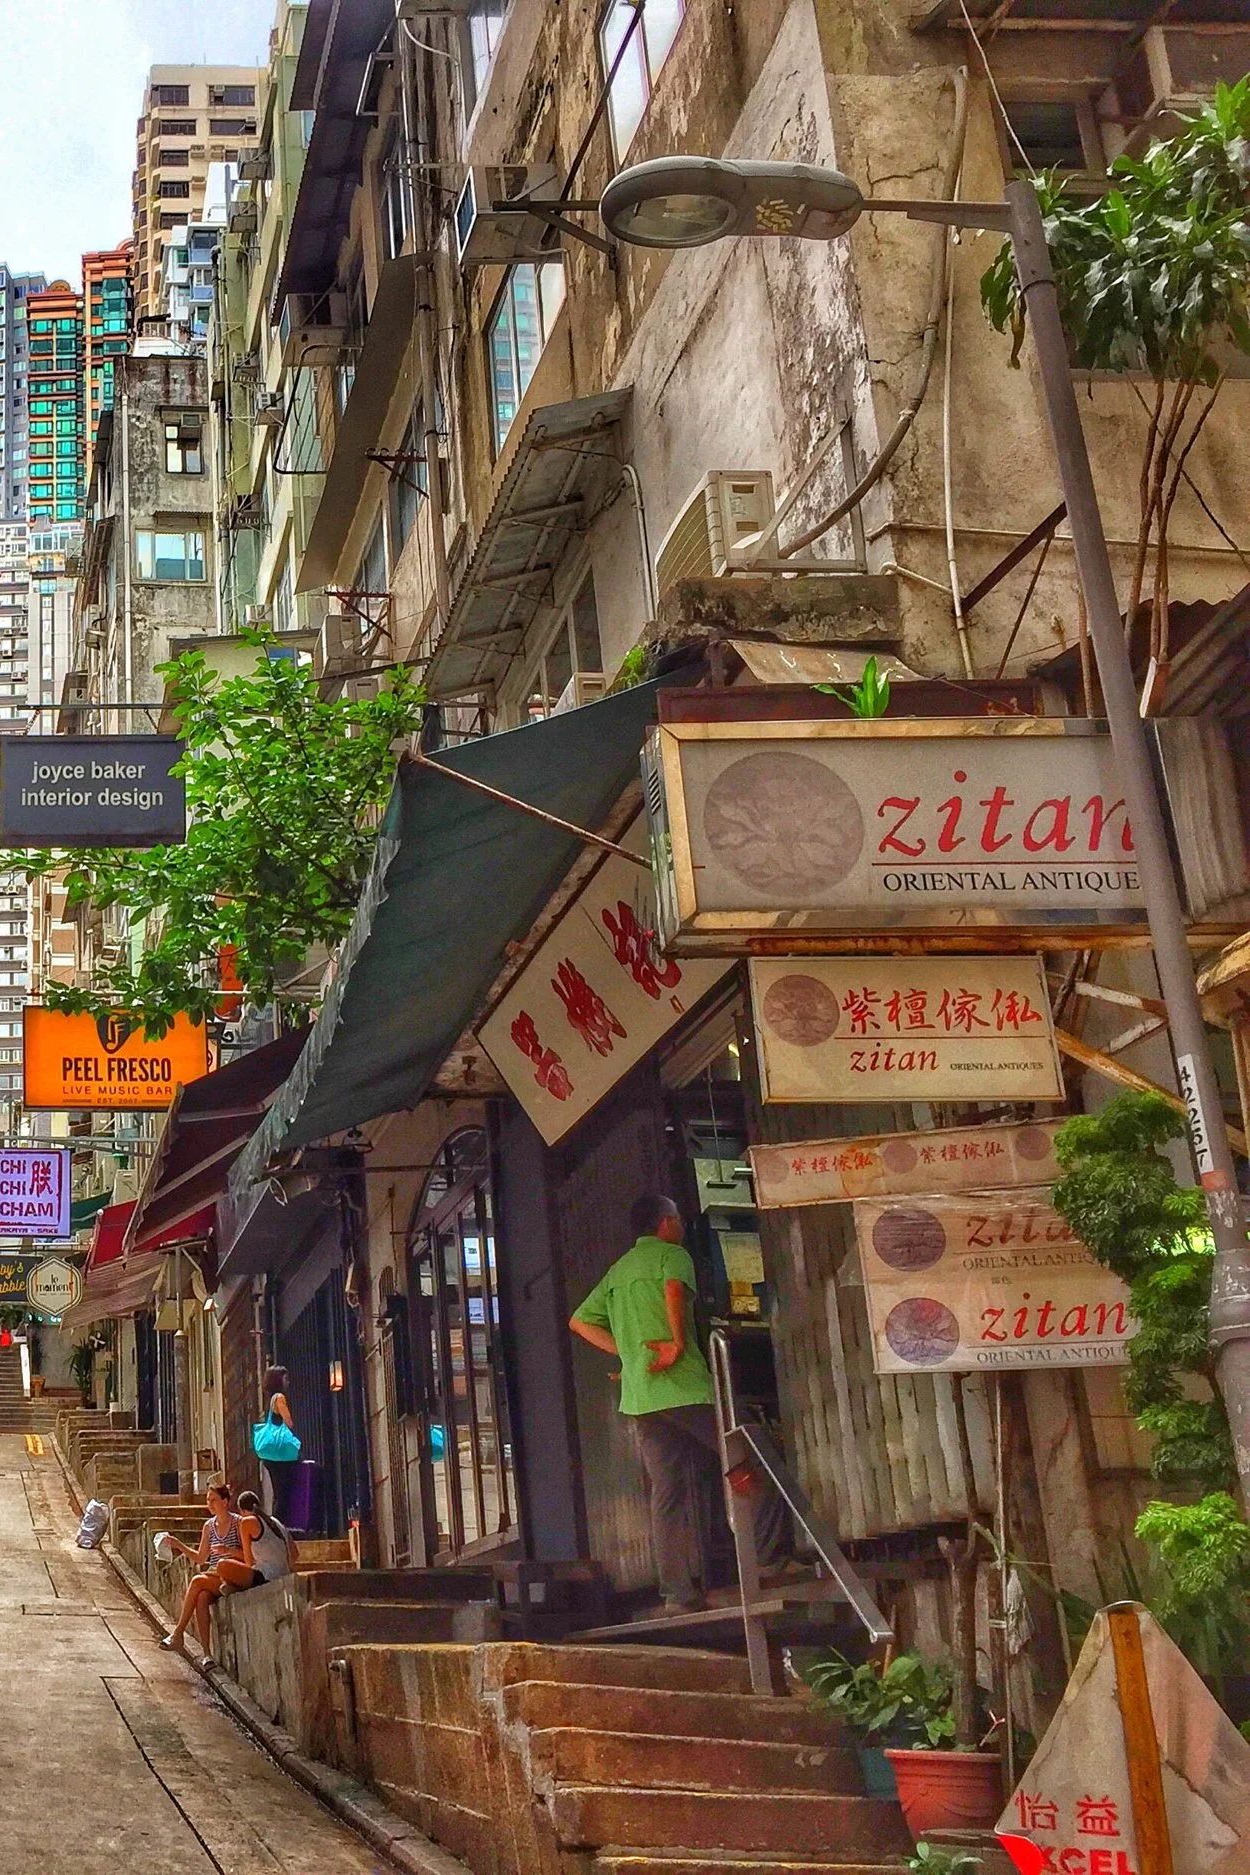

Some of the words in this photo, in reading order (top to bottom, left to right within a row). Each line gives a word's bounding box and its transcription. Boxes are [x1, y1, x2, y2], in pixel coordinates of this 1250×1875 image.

[31, 761, 85, 784] joyce
[91, 761, 146, 779] baker
[21, 788, 92, 806] interior
[97, 788, 164, 810] design
[876, 770, 1135, 857] zitan
[883, 871, 1015, 893] ORIENTAL
[842, 987, 1043, 1034] 紫檀傢俬
[849, 1042, 939, 1073] zitan
[950, 1062, 996, 1071] ORIENTAL
[997, 1062, 1044, 1072] ANTIQUES
[62, 1057, 103, 1082] PEEL
[107, 1057, 172, 1082] FRESCO
[62, 1086, 91, 1095] LIVE
[98, 1086, 140, 1096] MUSIC
[146, 1086, 173, 1095] BAR
[0, 1160, 26, 1174] CHI
[0, 1181, 26, 1195] CHI
[0, 1202, 53, 1217] CHAM
[963, 1256, 1043, 1272] ORIENTAL
[980, 1292, 1129, 1342] zitan
[976, 1350, 1057, 1365] ORIENTAL
